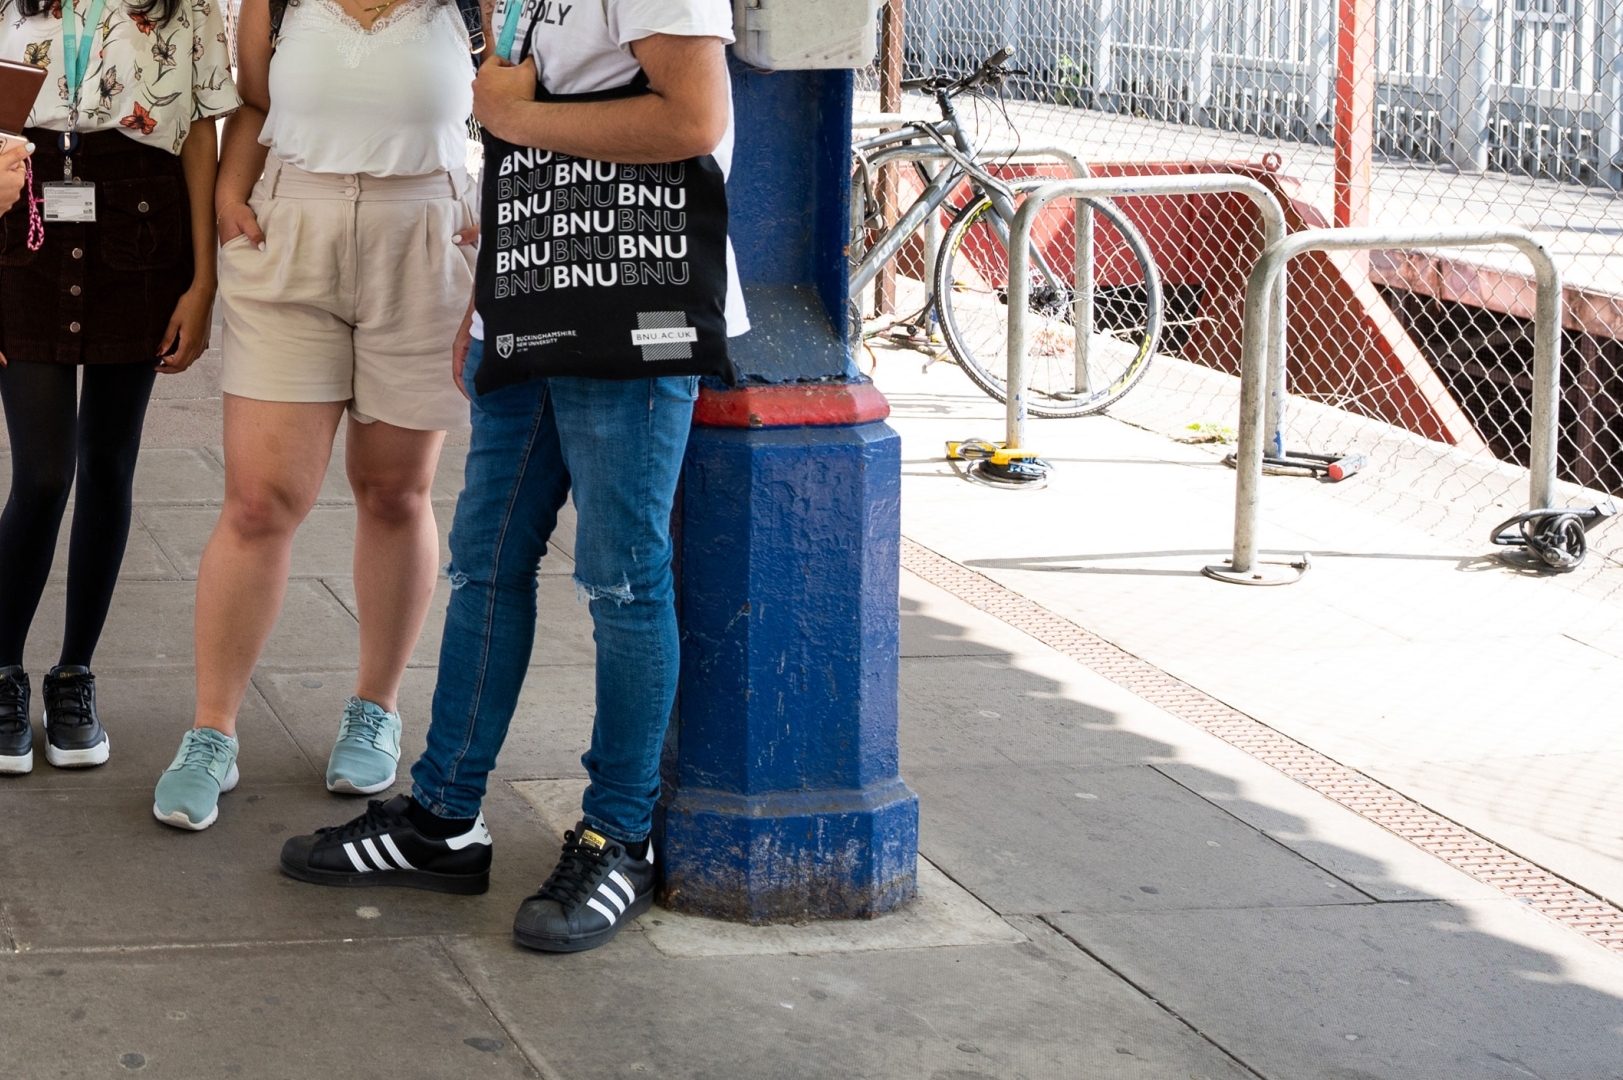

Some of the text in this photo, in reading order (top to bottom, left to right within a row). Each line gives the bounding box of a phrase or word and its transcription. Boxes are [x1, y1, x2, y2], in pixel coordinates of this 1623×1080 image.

[497, 159, 685, 200] BNU BNU BNU
[499, 148, 552, 176] BNU
[497, 183, 686, 225] BNU BNU BNU
[497, 208, 686, 249] BNU BNU BNU
[496, 235, 687, 274] BNU BNU BNU
[494, 262, 690, 299] BNU BNU BNU
[516, 330, 577, 342] BUCKINGHAMSHIRE
[528, 338, 558, 347] UNIVERSITY
[636, 331, 692, 341] BNU.AC.UK
